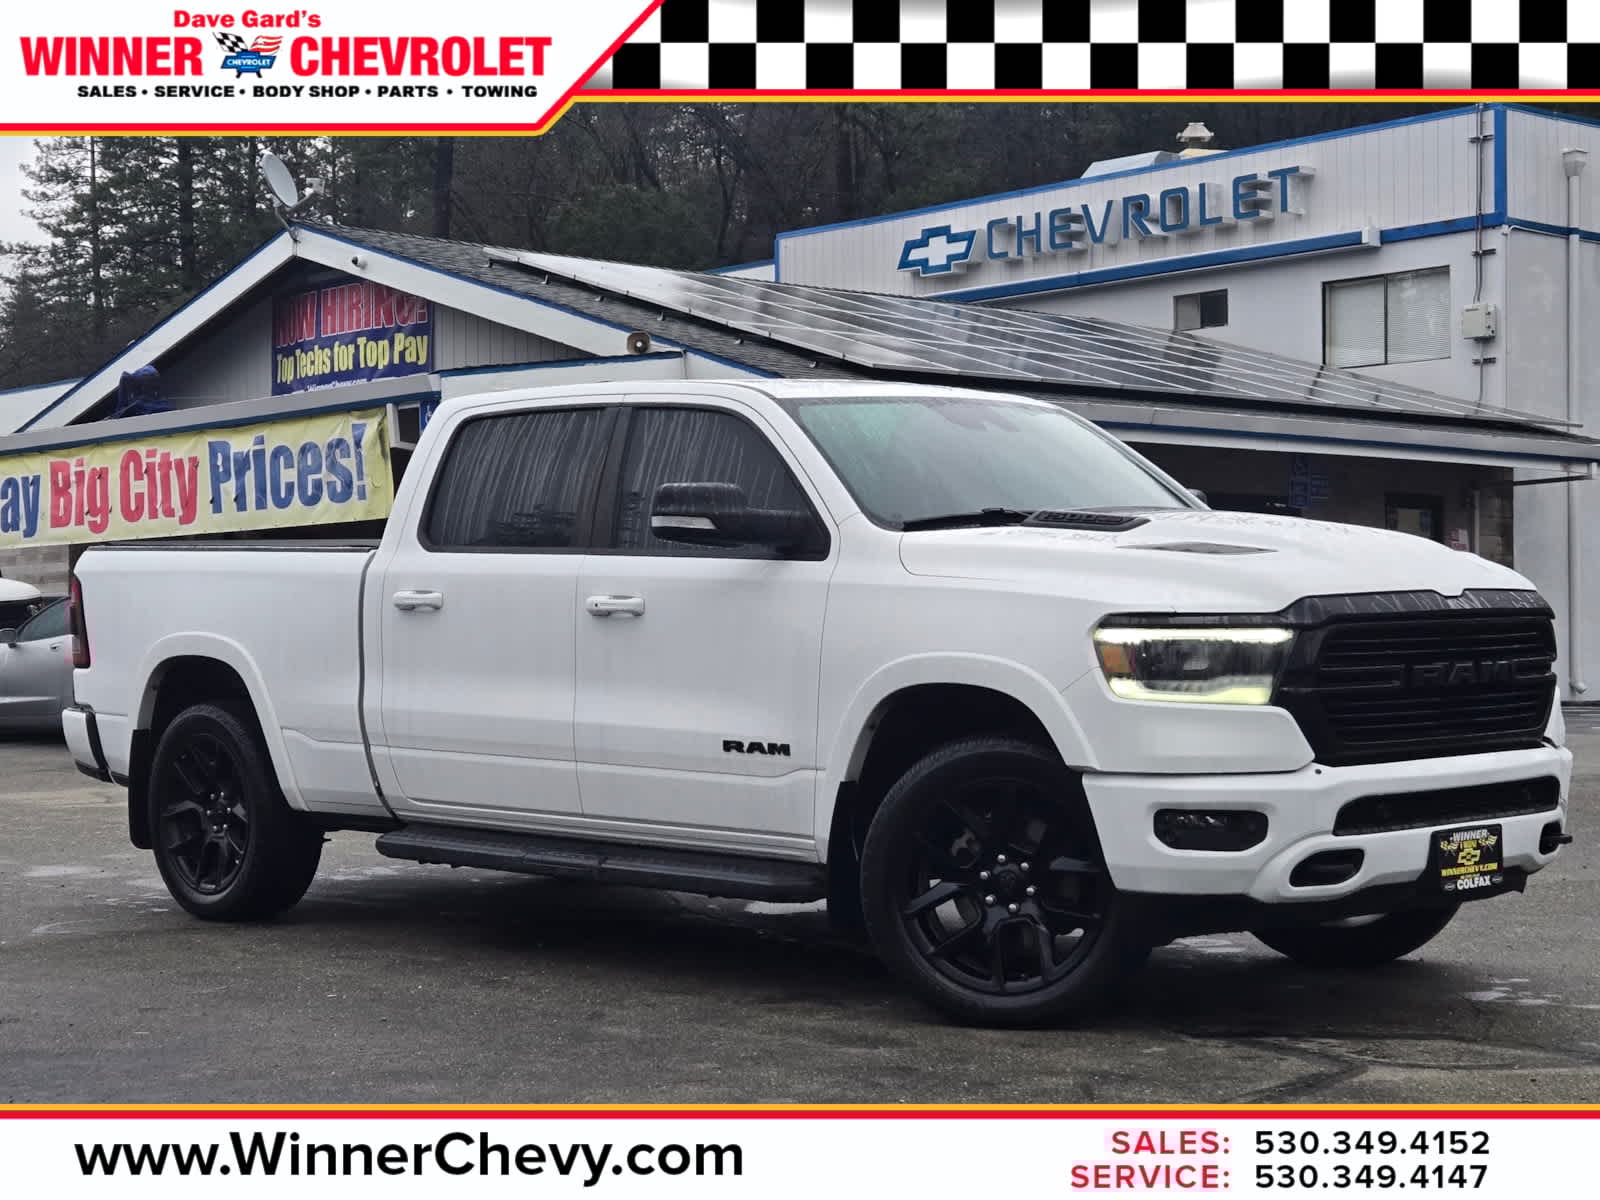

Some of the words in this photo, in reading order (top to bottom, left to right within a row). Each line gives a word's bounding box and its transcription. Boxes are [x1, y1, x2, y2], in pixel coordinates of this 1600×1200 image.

[986, 165, 1303, 261] CHEVROLET
[276, 353, 295, 384] Top
[295, 344, 331, 379] Techs
[333, 341, 355, 373] for
[357, 336, 390, 370] Top
[392, 332, 429, 366] Pay
[48, 458, 110, 535] Big
[118, 447, 200, 525] City
[207, 422, 368, 514] Prices!
[1412, 660, 1509, 687] RAM
[722, 739, 791, 757] RAM
[1457, 876, 1491, 890] COLFAX
